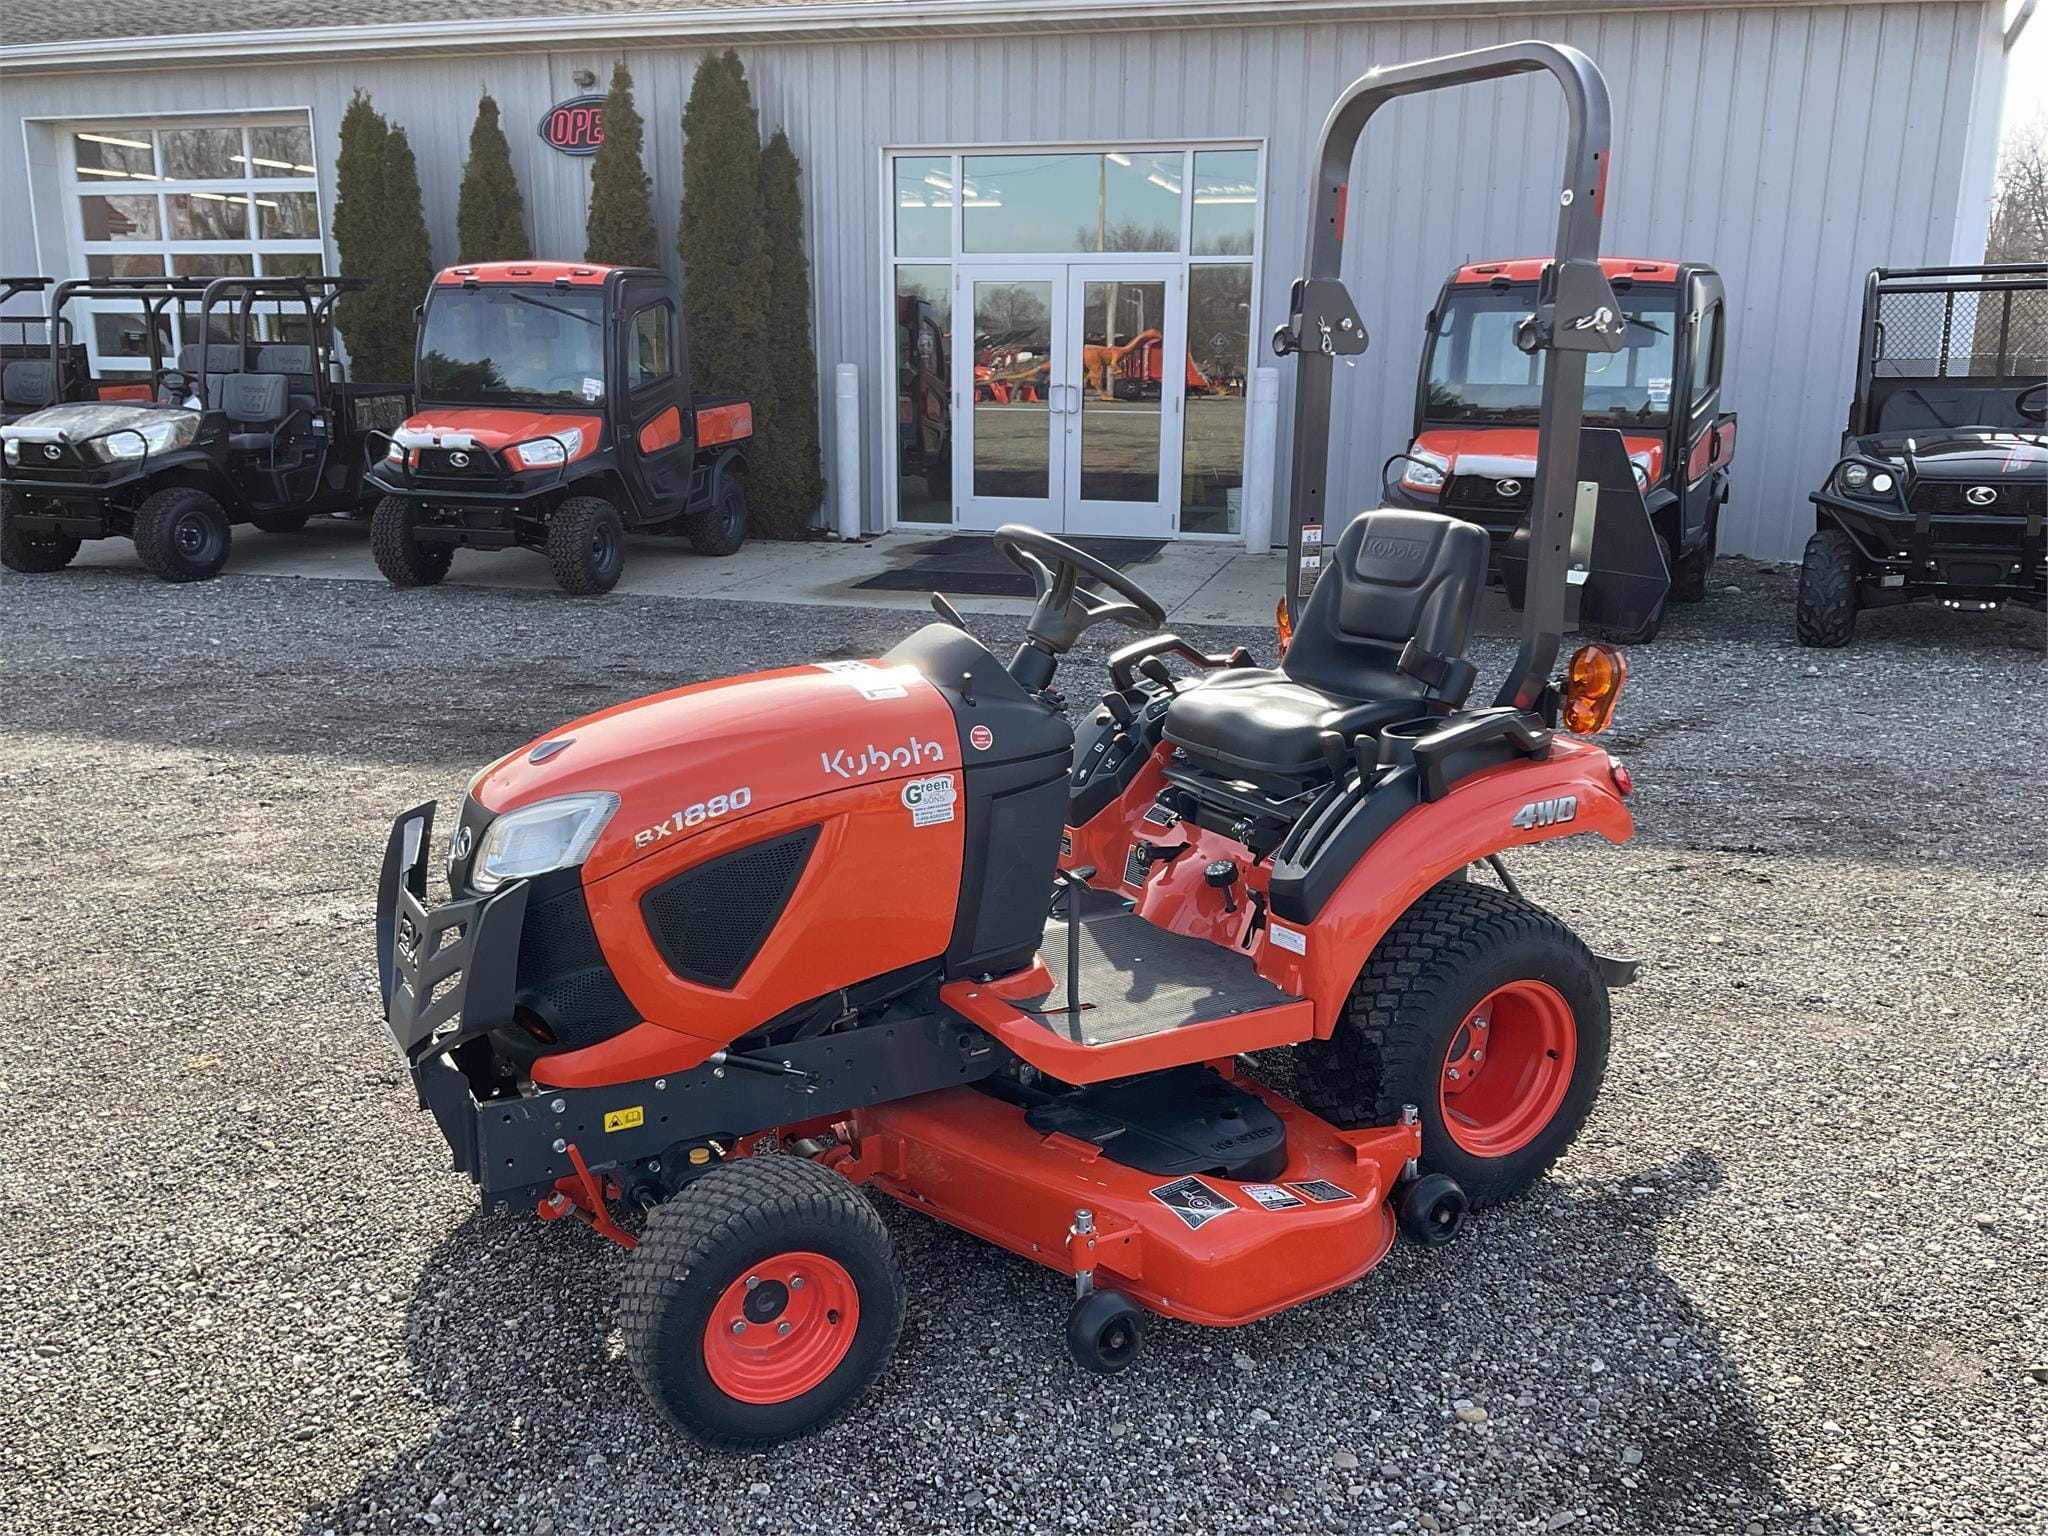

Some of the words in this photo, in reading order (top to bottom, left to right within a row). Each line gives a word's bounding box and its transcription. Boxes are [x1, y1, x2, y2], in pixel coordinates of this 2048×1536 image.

[549, 109, 605, 145] OPE
[1366, 538, 1421, 560] Kubota
[821, 736, 944, 778] Kubota
[905, 780, 949, 805] Green
[634, 786, 751, 849] BX1880
[1512, 795, 1578, 830] 4WD
[1236, 1126, 1274, 1145] STEP
